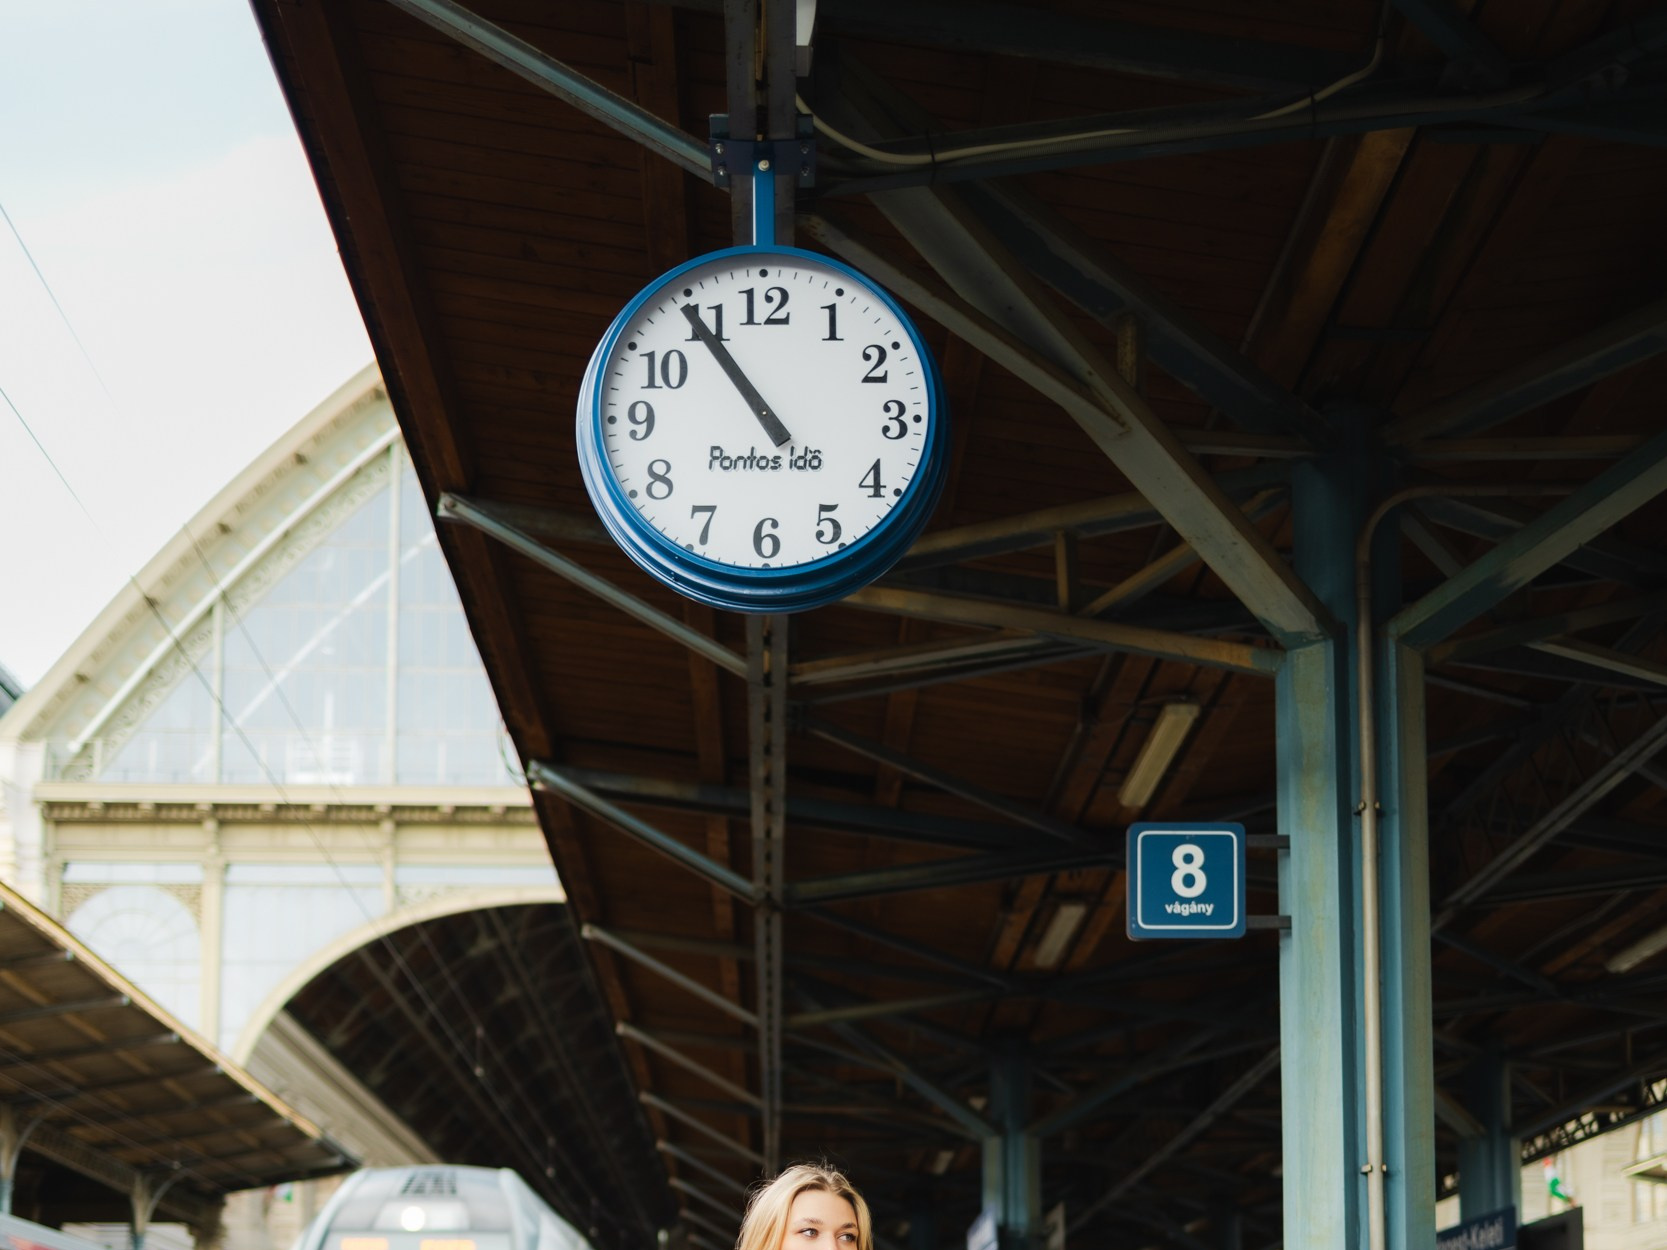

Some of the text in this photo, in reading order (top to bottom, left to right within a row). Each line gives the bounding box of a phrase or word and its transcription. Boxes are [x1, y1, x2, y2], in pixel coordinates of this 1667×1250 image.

[684, 303, 730, 341] 11
[739, 287, 790, 325] 12
[820, 303, 844, 341] 1
[639, 349, 688, 389] 10
[861, 345, 888, 383] 2
[627, 400, 655, 441] 9
[881, 400, 908, 439] 3
[709, 445, 782, 470] Pontos
[645, 459, 674, 500] 8
[858, 458, 887, 498] 4
[690, 505, 717, 545] 7
[752, 518, 781, 559] 6
[815, 504, 842, 545] 5
[1171, 843, 1207, 898] 8
[1165, 901, 1214, 916] vágány
